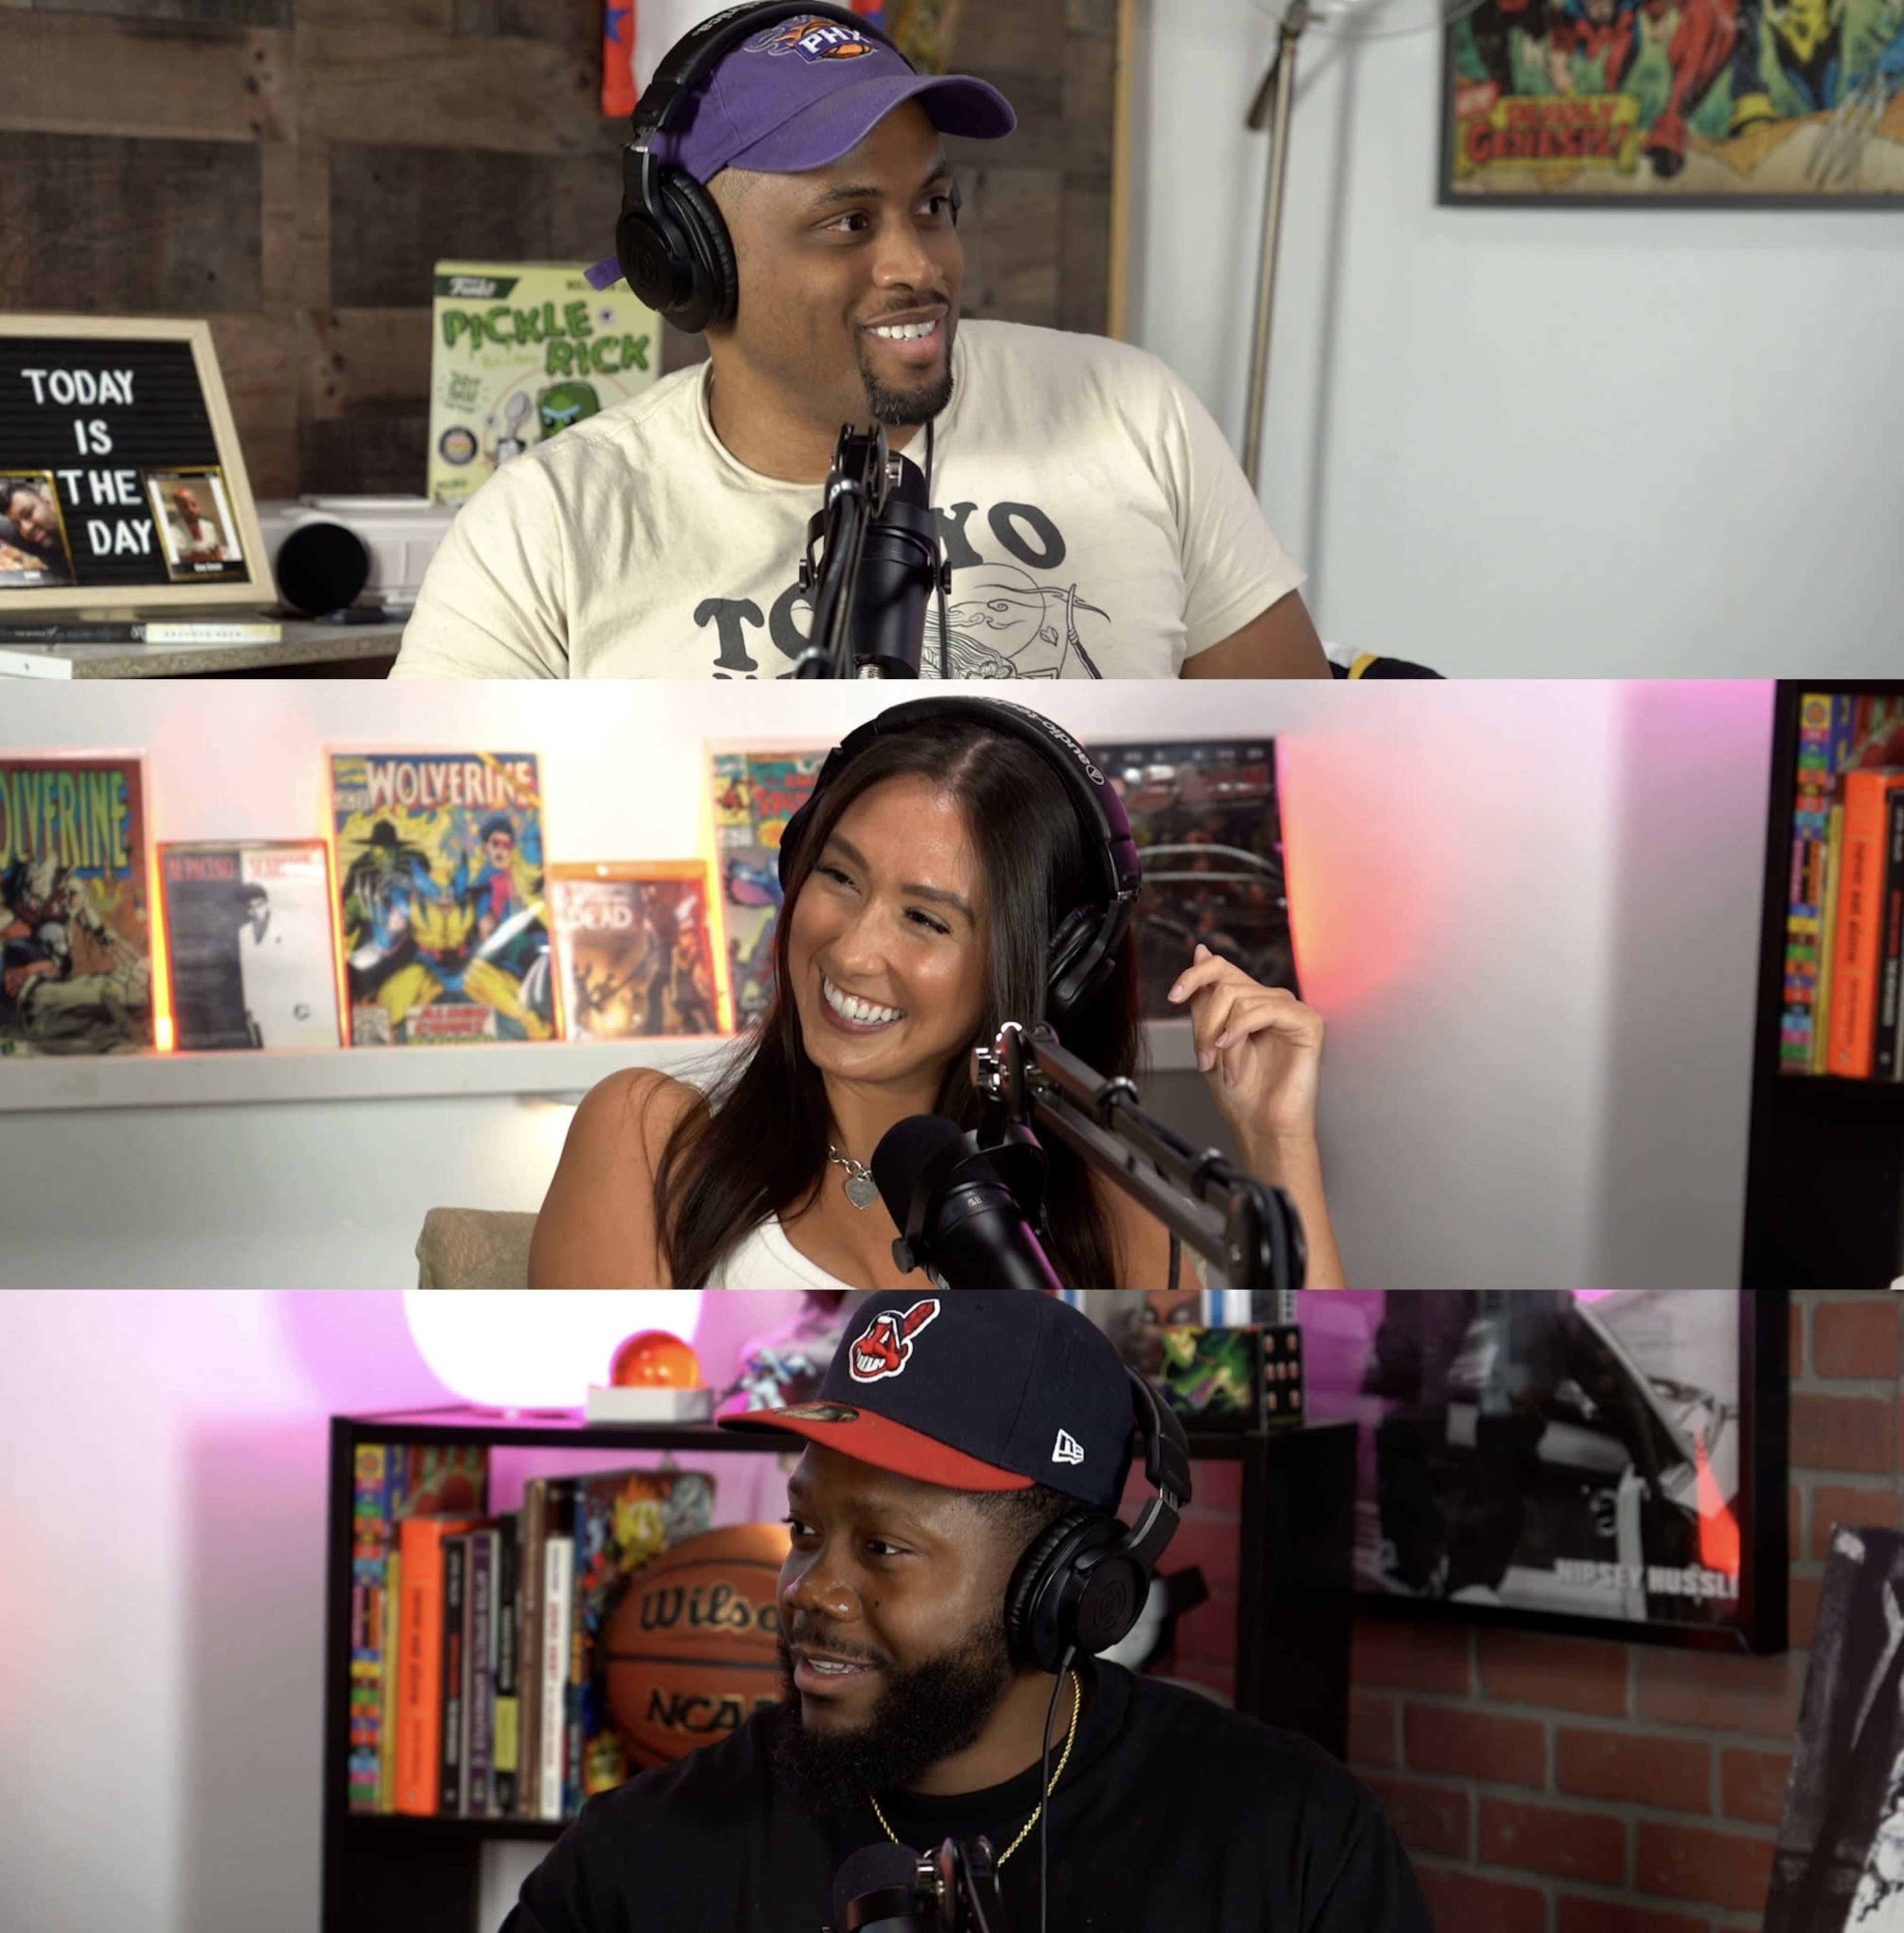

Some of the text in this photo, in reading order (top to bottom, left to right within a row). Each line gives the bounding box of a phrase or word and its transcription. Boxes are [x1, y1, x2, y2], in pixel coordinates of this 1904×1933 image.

[799, 26, 869, 54] PHX
[441, 300, 594, 351] PICKLE
[545, 333, 651, 377] RICK
[21, 369, 135, 405] TODAY
[74, 419, 114, 455] IS
[57, 469, 142, 505] THE
[87, 519, 153, 556] DAY
[366, 760, 534, 809] WOLVERINE
[641, 1585, 781, 1632] Wilso
[646, 1688, 779, 1732] NCA
